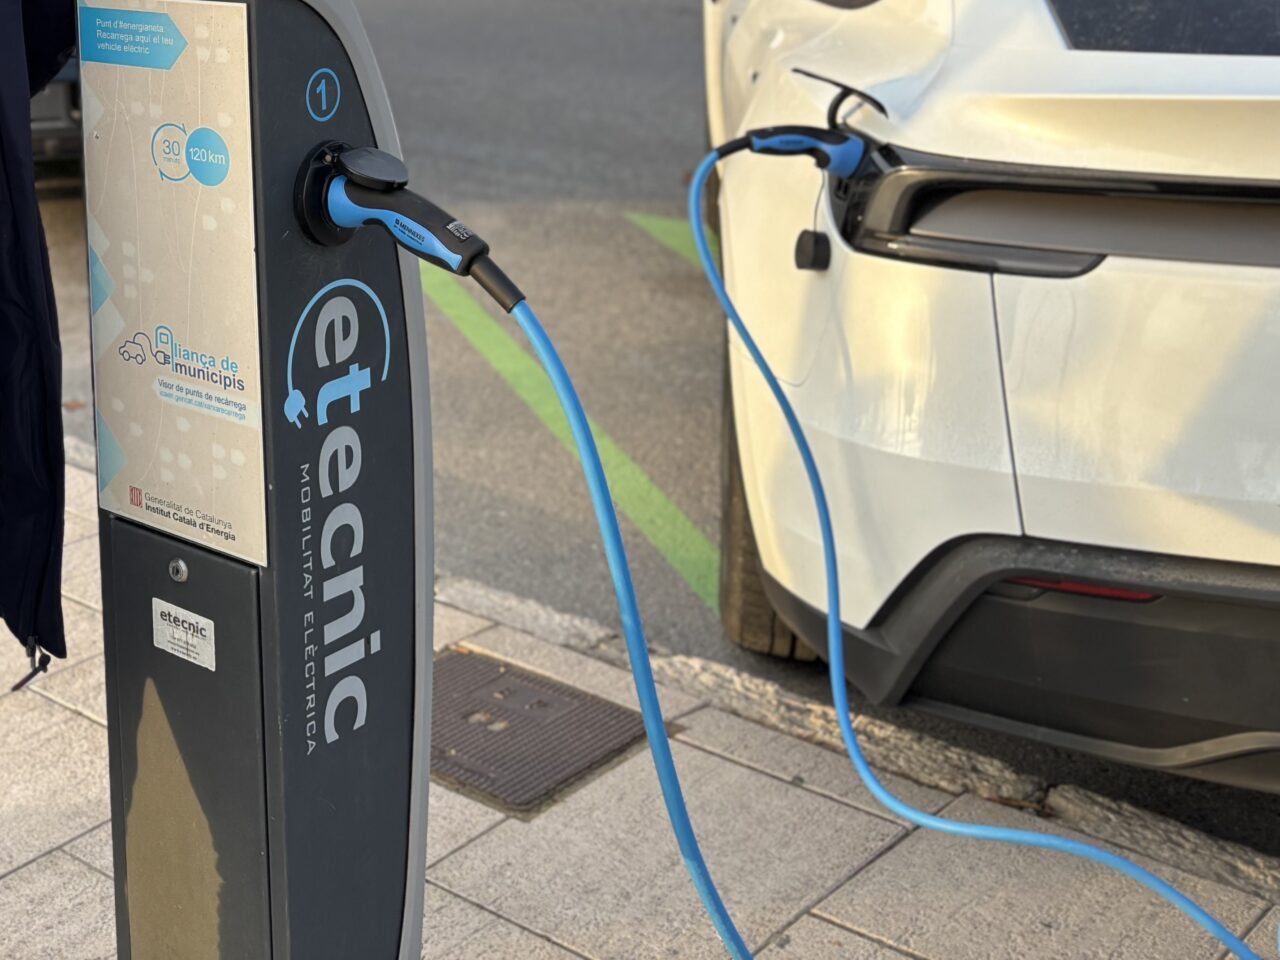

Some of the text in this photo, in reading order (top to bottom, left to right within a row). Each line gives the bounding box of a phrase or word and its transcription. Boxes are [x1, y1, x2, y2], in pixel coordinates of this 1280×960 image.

[96, 18, 112, 28] Punt
[96, 29, 133, 43] Recarrega
[152, 35, 160, 44] el
[161, 36, 174, 46] teu
[97, 42, 122, 52] vehicle
[316, 79, 327, 111] 1
[162, 139, 180, 156] 30
[189, 147, 207, 162] 120
[208, 149, 226, 165] km
[174, 361, 246, 392] municipis
[220, 356, 239, 374] de
[157, 378, 174, 390] Visor
[175, 383, 184, 393] de
[185, 387, 203, 399] punts
[204, 392, 213, 401] de
[144, 492, 233, 530] Generalitat de Catalunya
[145, 502, 236, 541] Institut Català d'Energia
[315, 296, 381, 744] etecnic
[300, 463, 317, 756] MOBILITAT ELÈCTRICA
[159, 610, 207, 638] etecnic
